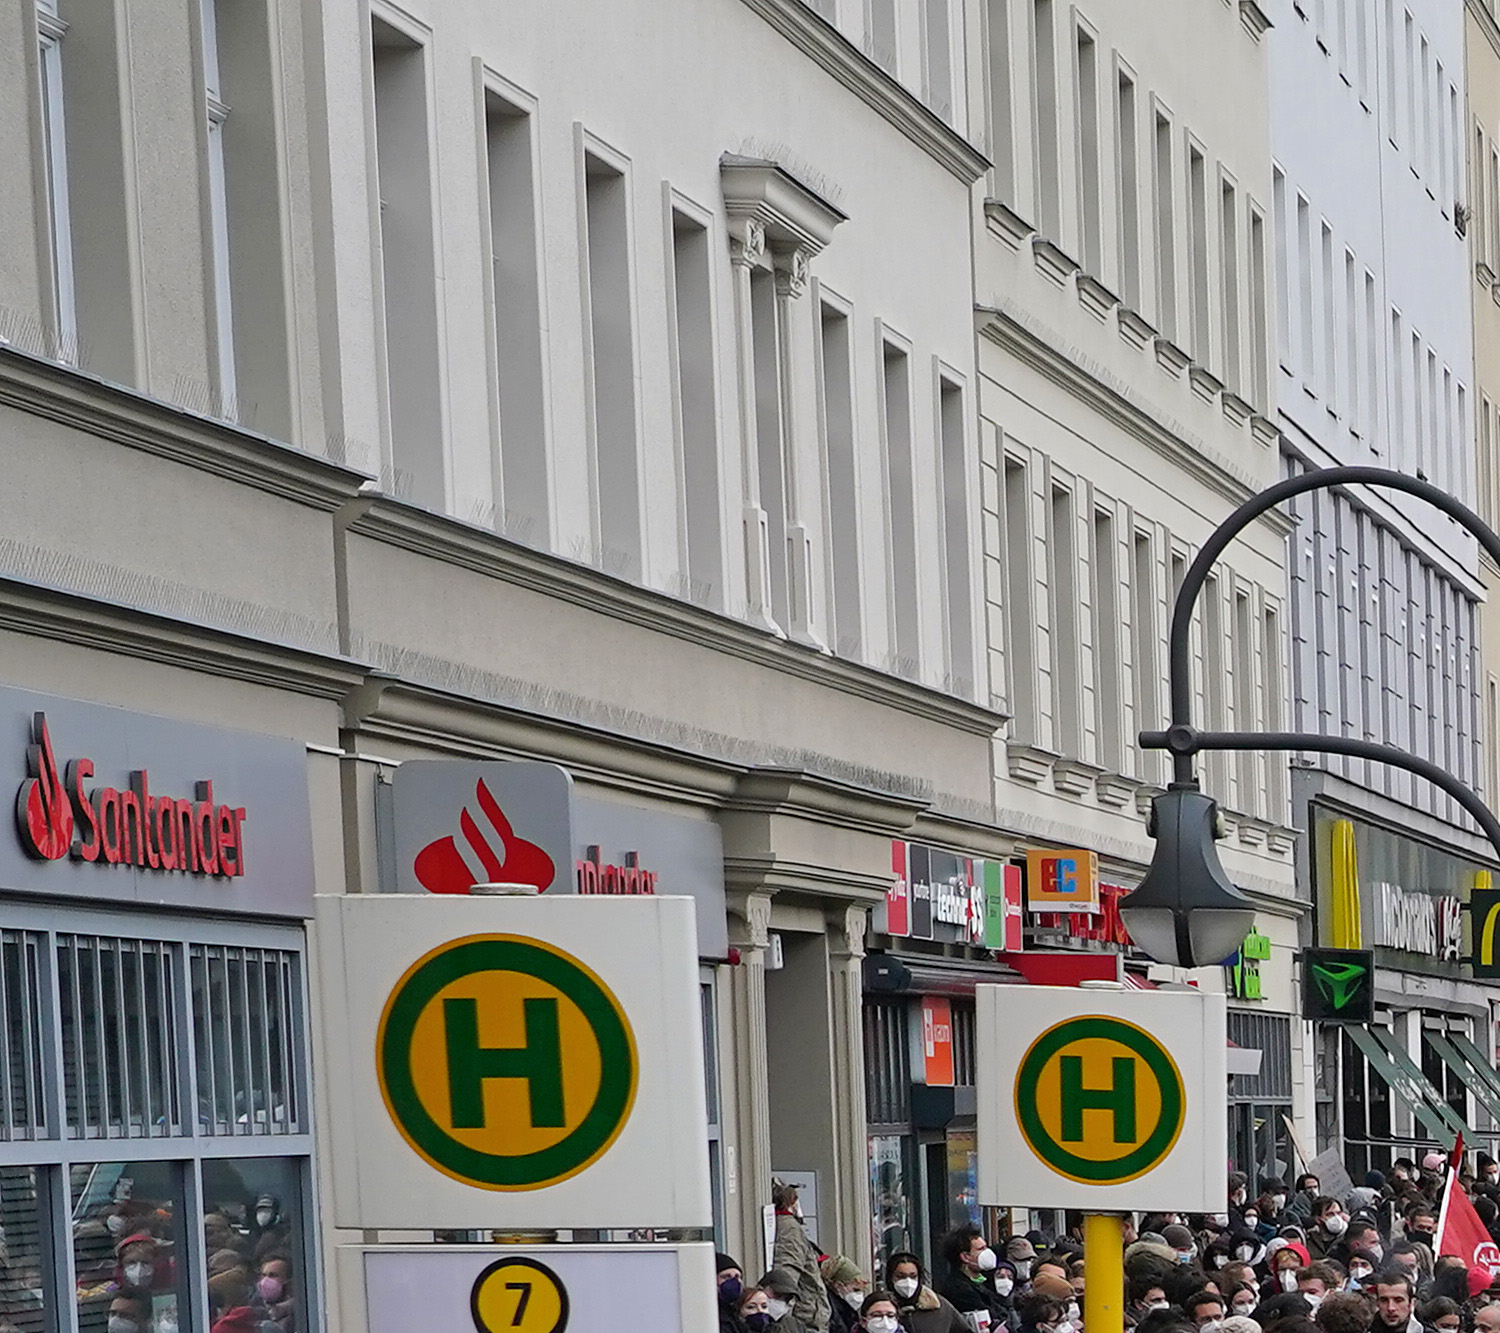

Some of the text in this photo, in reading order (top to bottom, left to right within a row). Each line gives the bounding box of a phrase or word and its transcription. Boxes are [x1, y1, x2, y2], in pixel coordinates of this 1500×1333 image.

[66, 757, 248, 879] Santander
[443, 998, 566, 1129] H
[1060, 1055, 1137, 1144] H
[504, 1282, 532, 1327] 7
